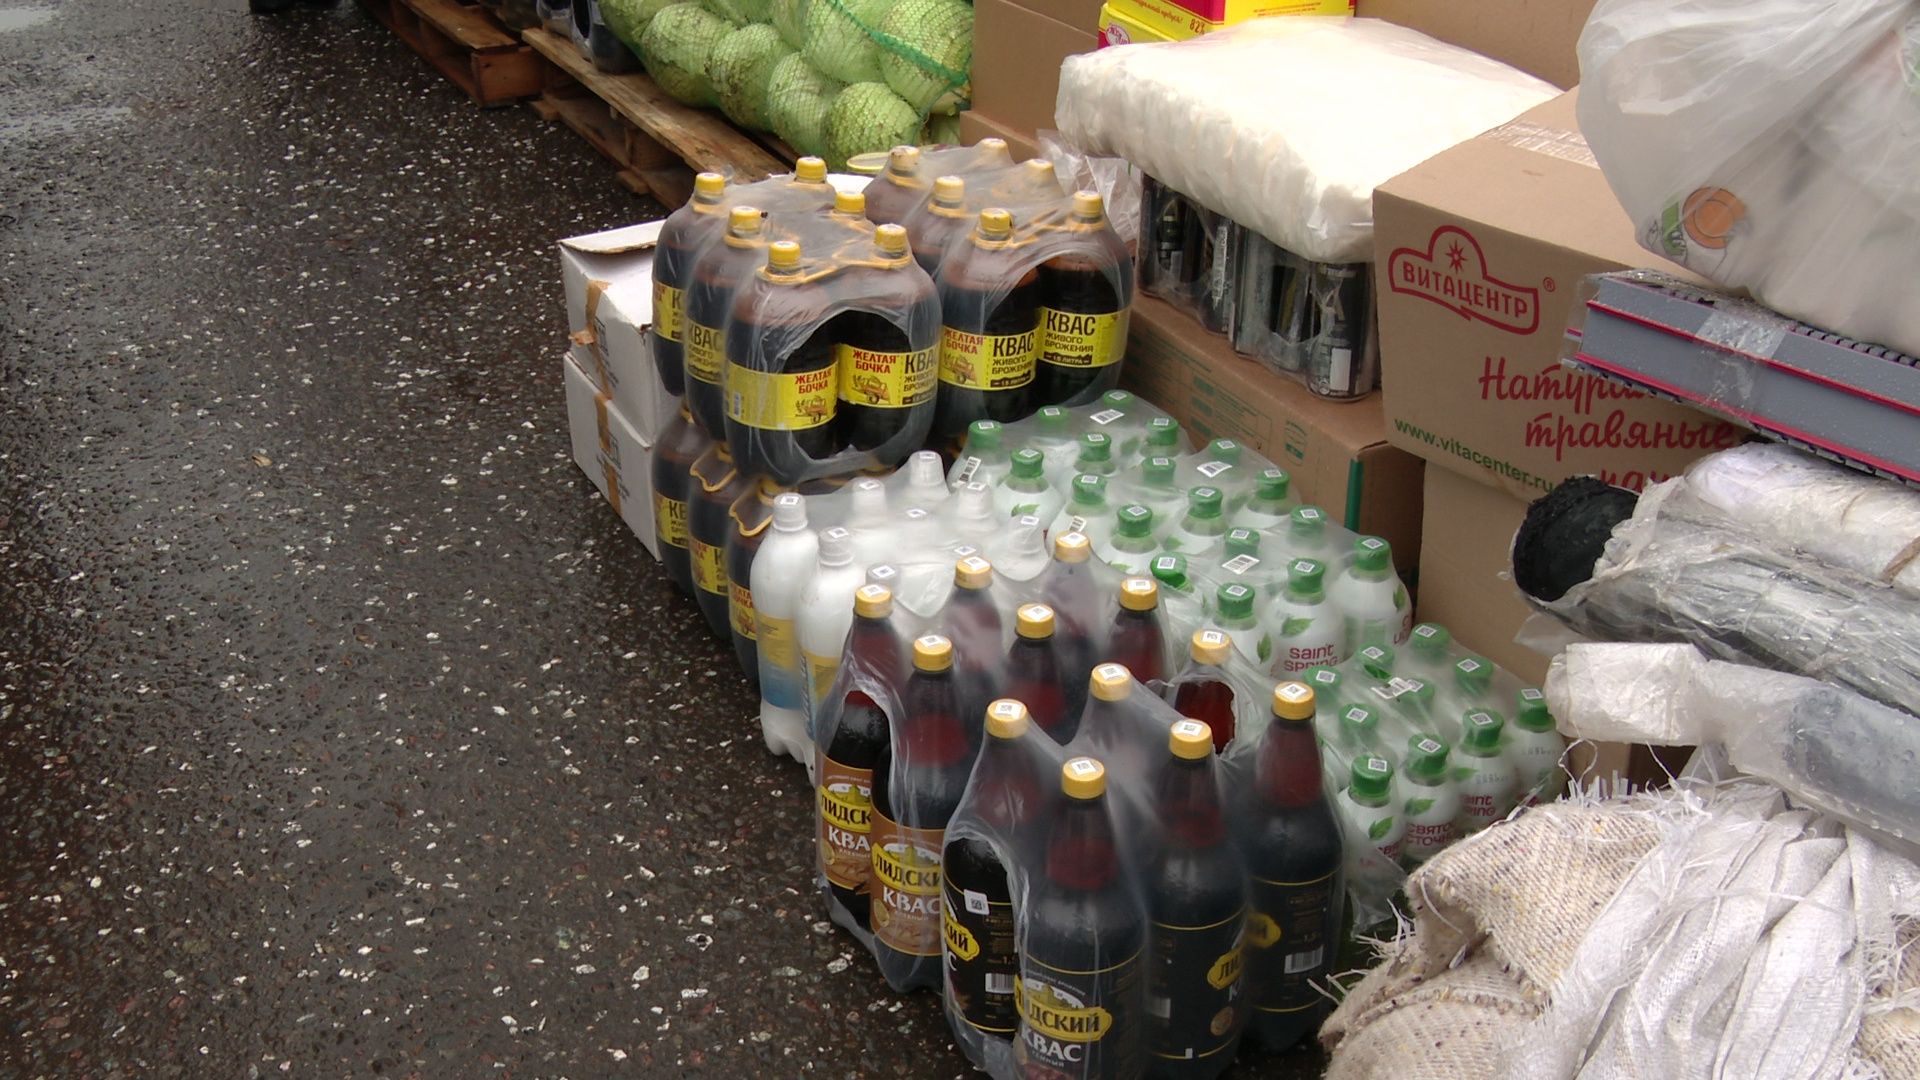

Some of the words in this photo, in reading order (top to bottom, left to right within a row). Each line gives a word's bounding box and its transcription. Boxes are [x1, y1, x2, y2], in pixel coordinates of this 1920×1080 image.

[1402, 260, 1528, 318] ВИТАЦЕНТР
[1046, 311, 1096, 336] КВАС
[944, 329, 984, 346] ЖЕЛТАЯ
[993, 331, 1035, 357] КВАС
[1045, 331, 1083, 344] ЖИВОГО
[946, 339, 977, 355] БОЧКА
[1044, 340, 1094, 353] БРОЖЕНИЯ
[852, 349, 897, 364] ЖЕЛТАЯ
[904, 348, 937, 375] КВА
[992, 355, 1027, 367] ЖИВОГО
[855, 360, 891, 375] БОЧКА
[992, 362, 1033, 375] БРОЖЕНИ
[795, 368, 832, 385] ЖЕЛТАЯ
[798, 380, 828, 395] БОЧКА
[1525, 409, 1736, 462] травяные
[1393, 418, 1556, 493] www.vitacenter.ru
[1288, 643, 1335, 660] saint
[883, 884, 941, 915] КВАС
